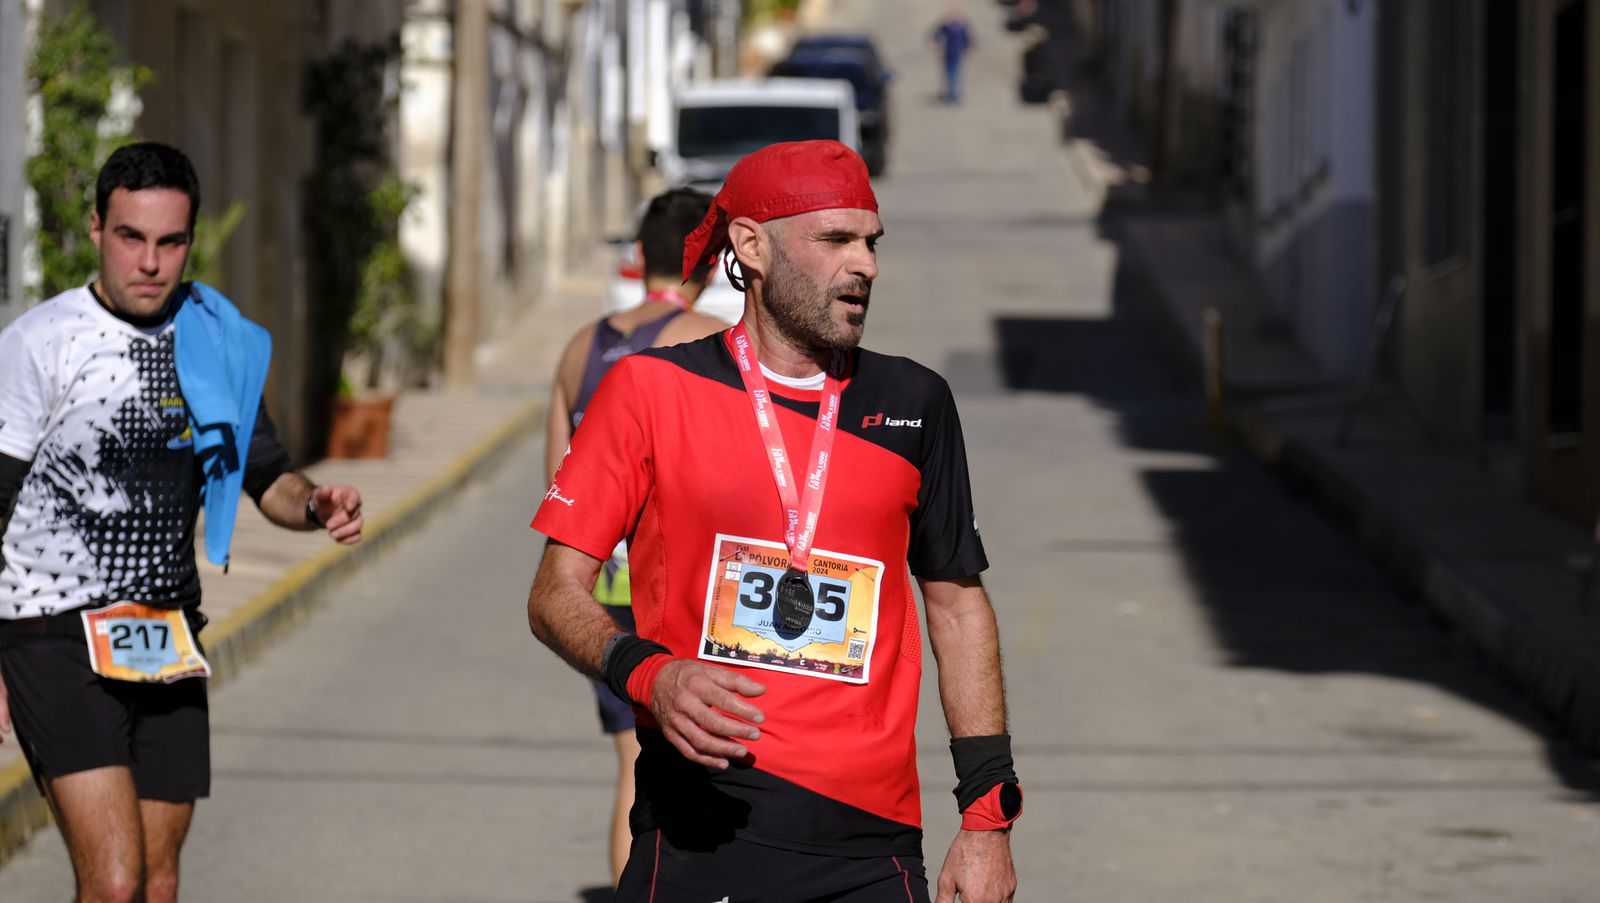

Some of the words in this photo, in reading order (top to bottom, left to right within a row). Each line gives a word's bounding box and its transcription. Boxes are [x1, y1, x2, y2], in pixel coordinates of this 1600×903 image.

[812, 567, 829, 575] 2024
[813, 559, 849, 572] CANTORIA
[740, 571, 847, 622] 35
[111, 625, 168, 650] 217
